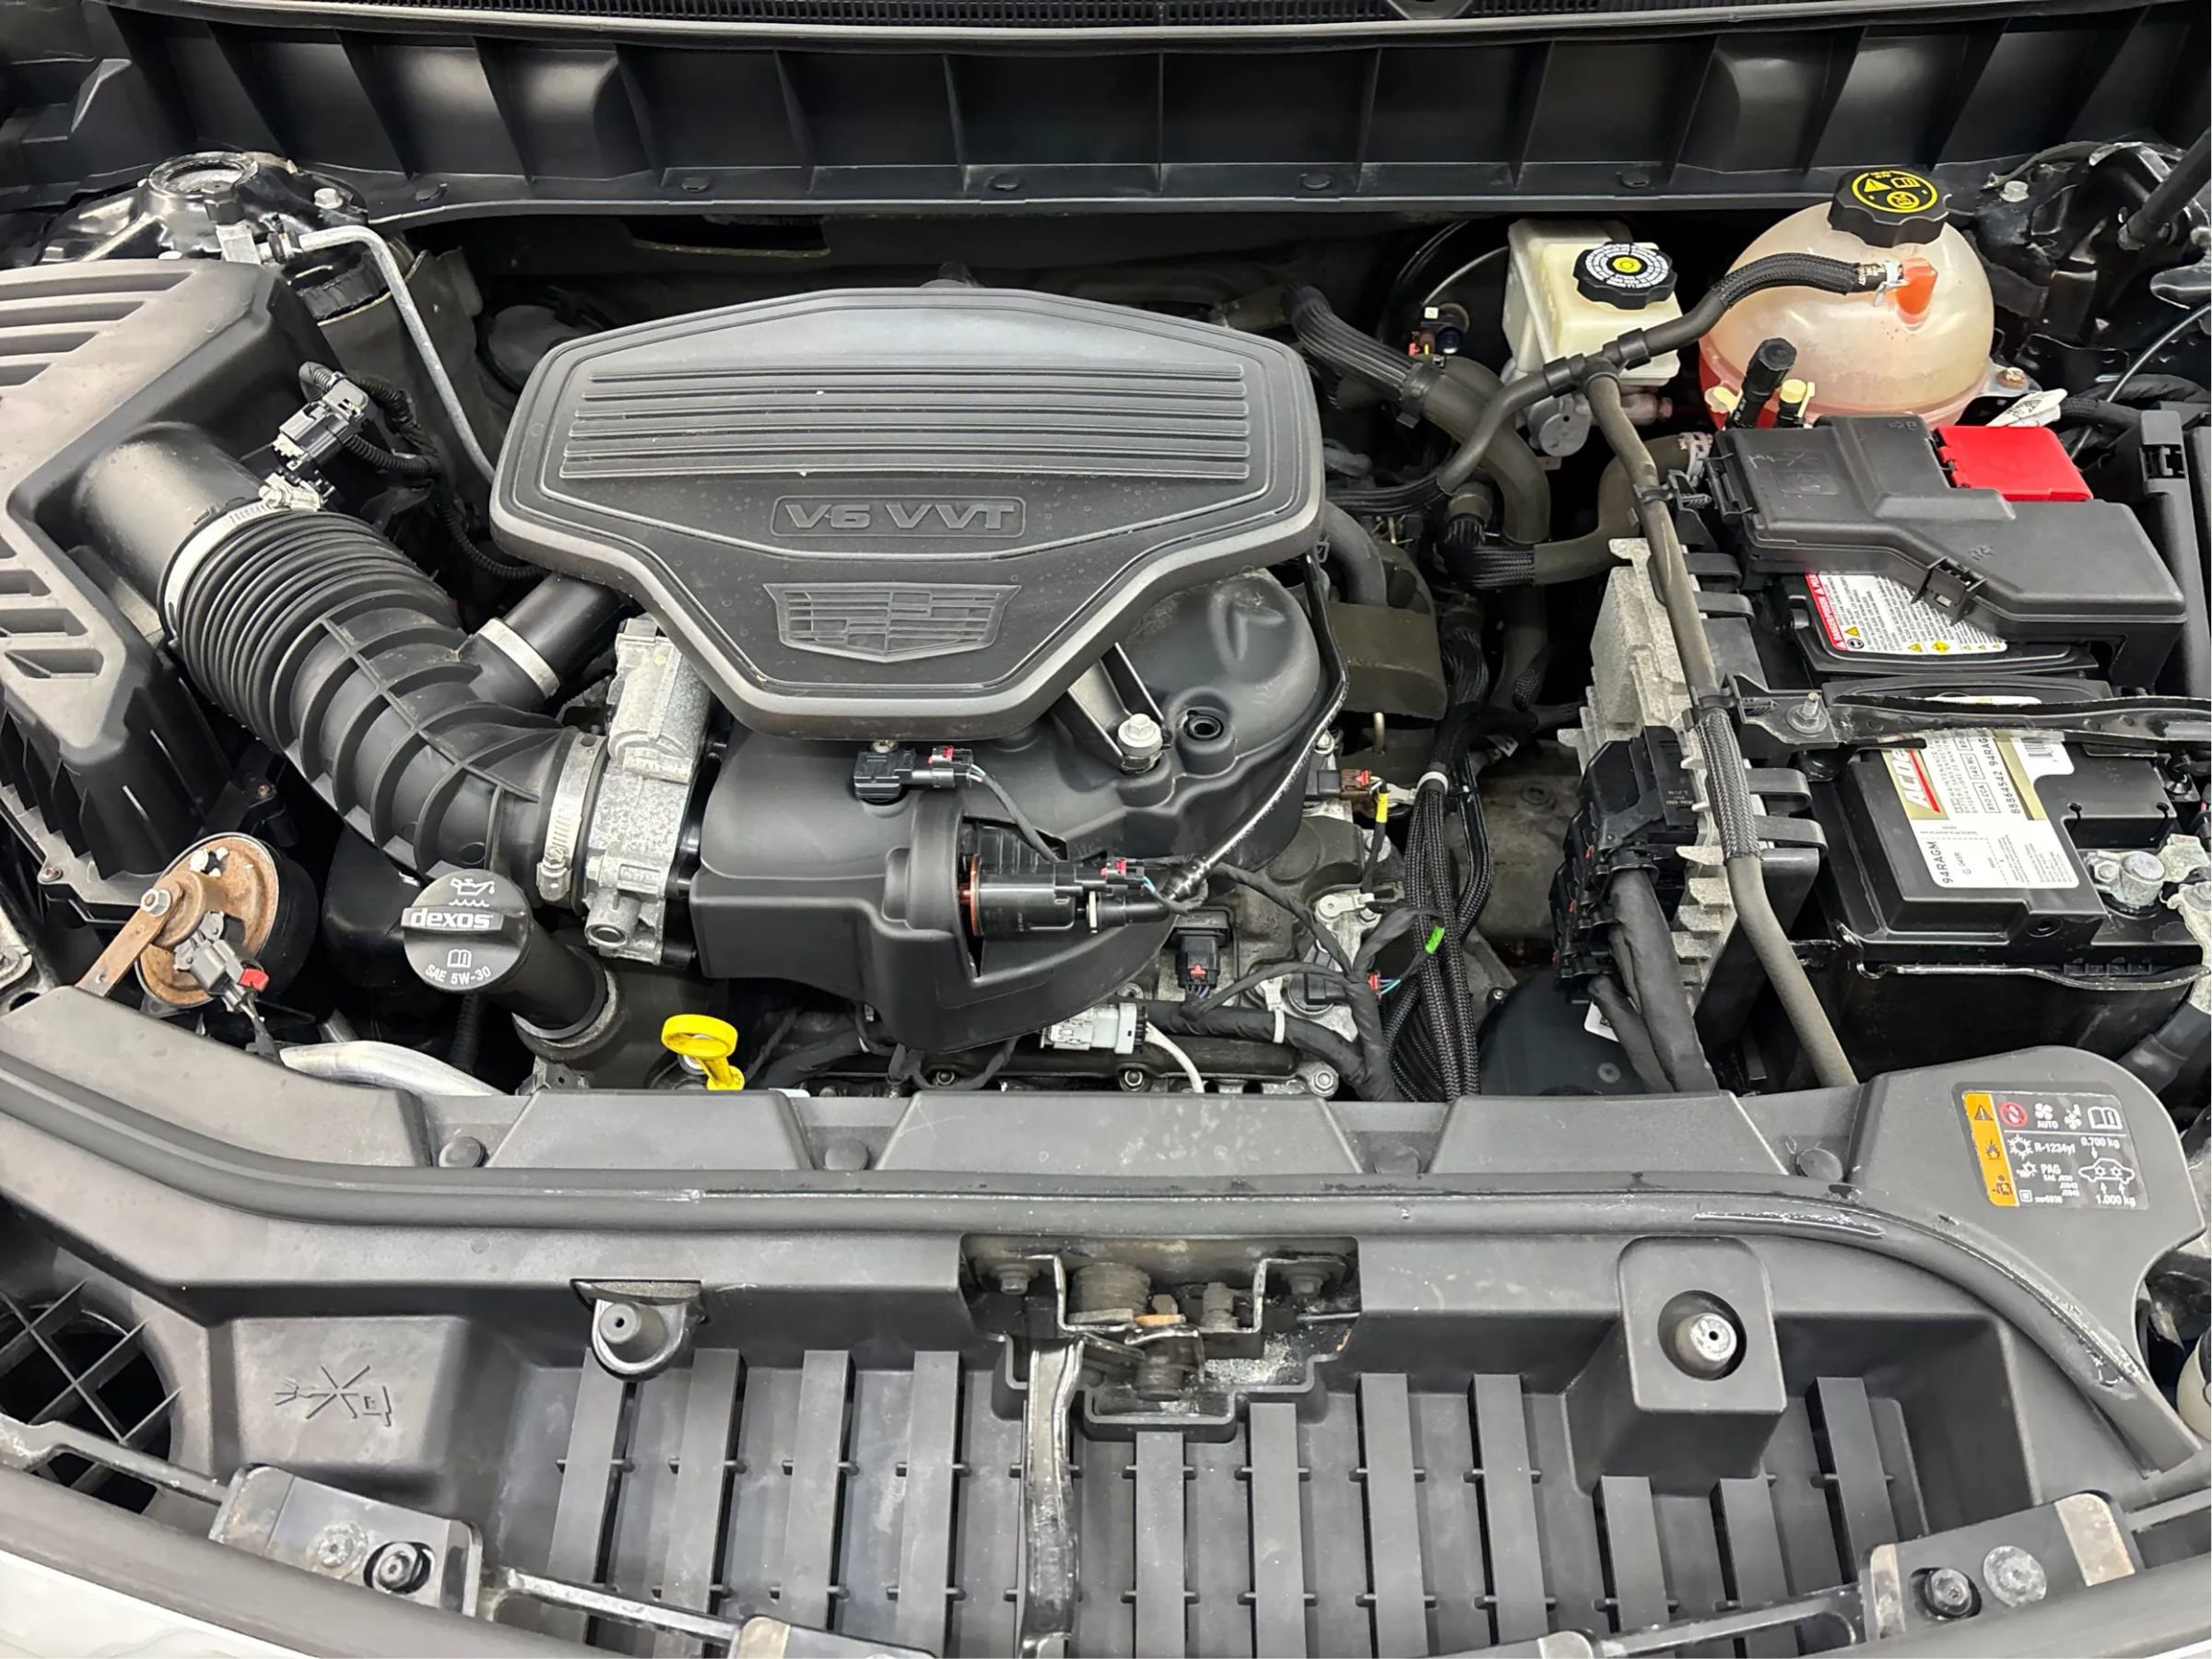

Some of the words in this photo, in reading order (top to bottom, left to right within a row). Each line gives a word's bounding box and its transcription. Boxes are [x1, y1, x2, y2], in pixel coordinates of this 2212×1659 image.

[784, 504, 871, 529] V6
[885, 504, 1015, 530] VVT
[1926, 841, 1954, 883] 94RAGM
[410, 908, 490, 929] dexos
[425, 964, 447, 982] SAE
[451, 966, 491, 985] 5W-30
[2037, 1120, 2059, 1130] AUTO
[2080, 1136, 2106, 1147] 0.700
[2107, 1137, 2121, 1149] kg
[2041, 1163, 2062, 1175] PAG
[2095, 1194, 2122, 1206] 1.000
[2123, 1195, 2136, 1207] kg
